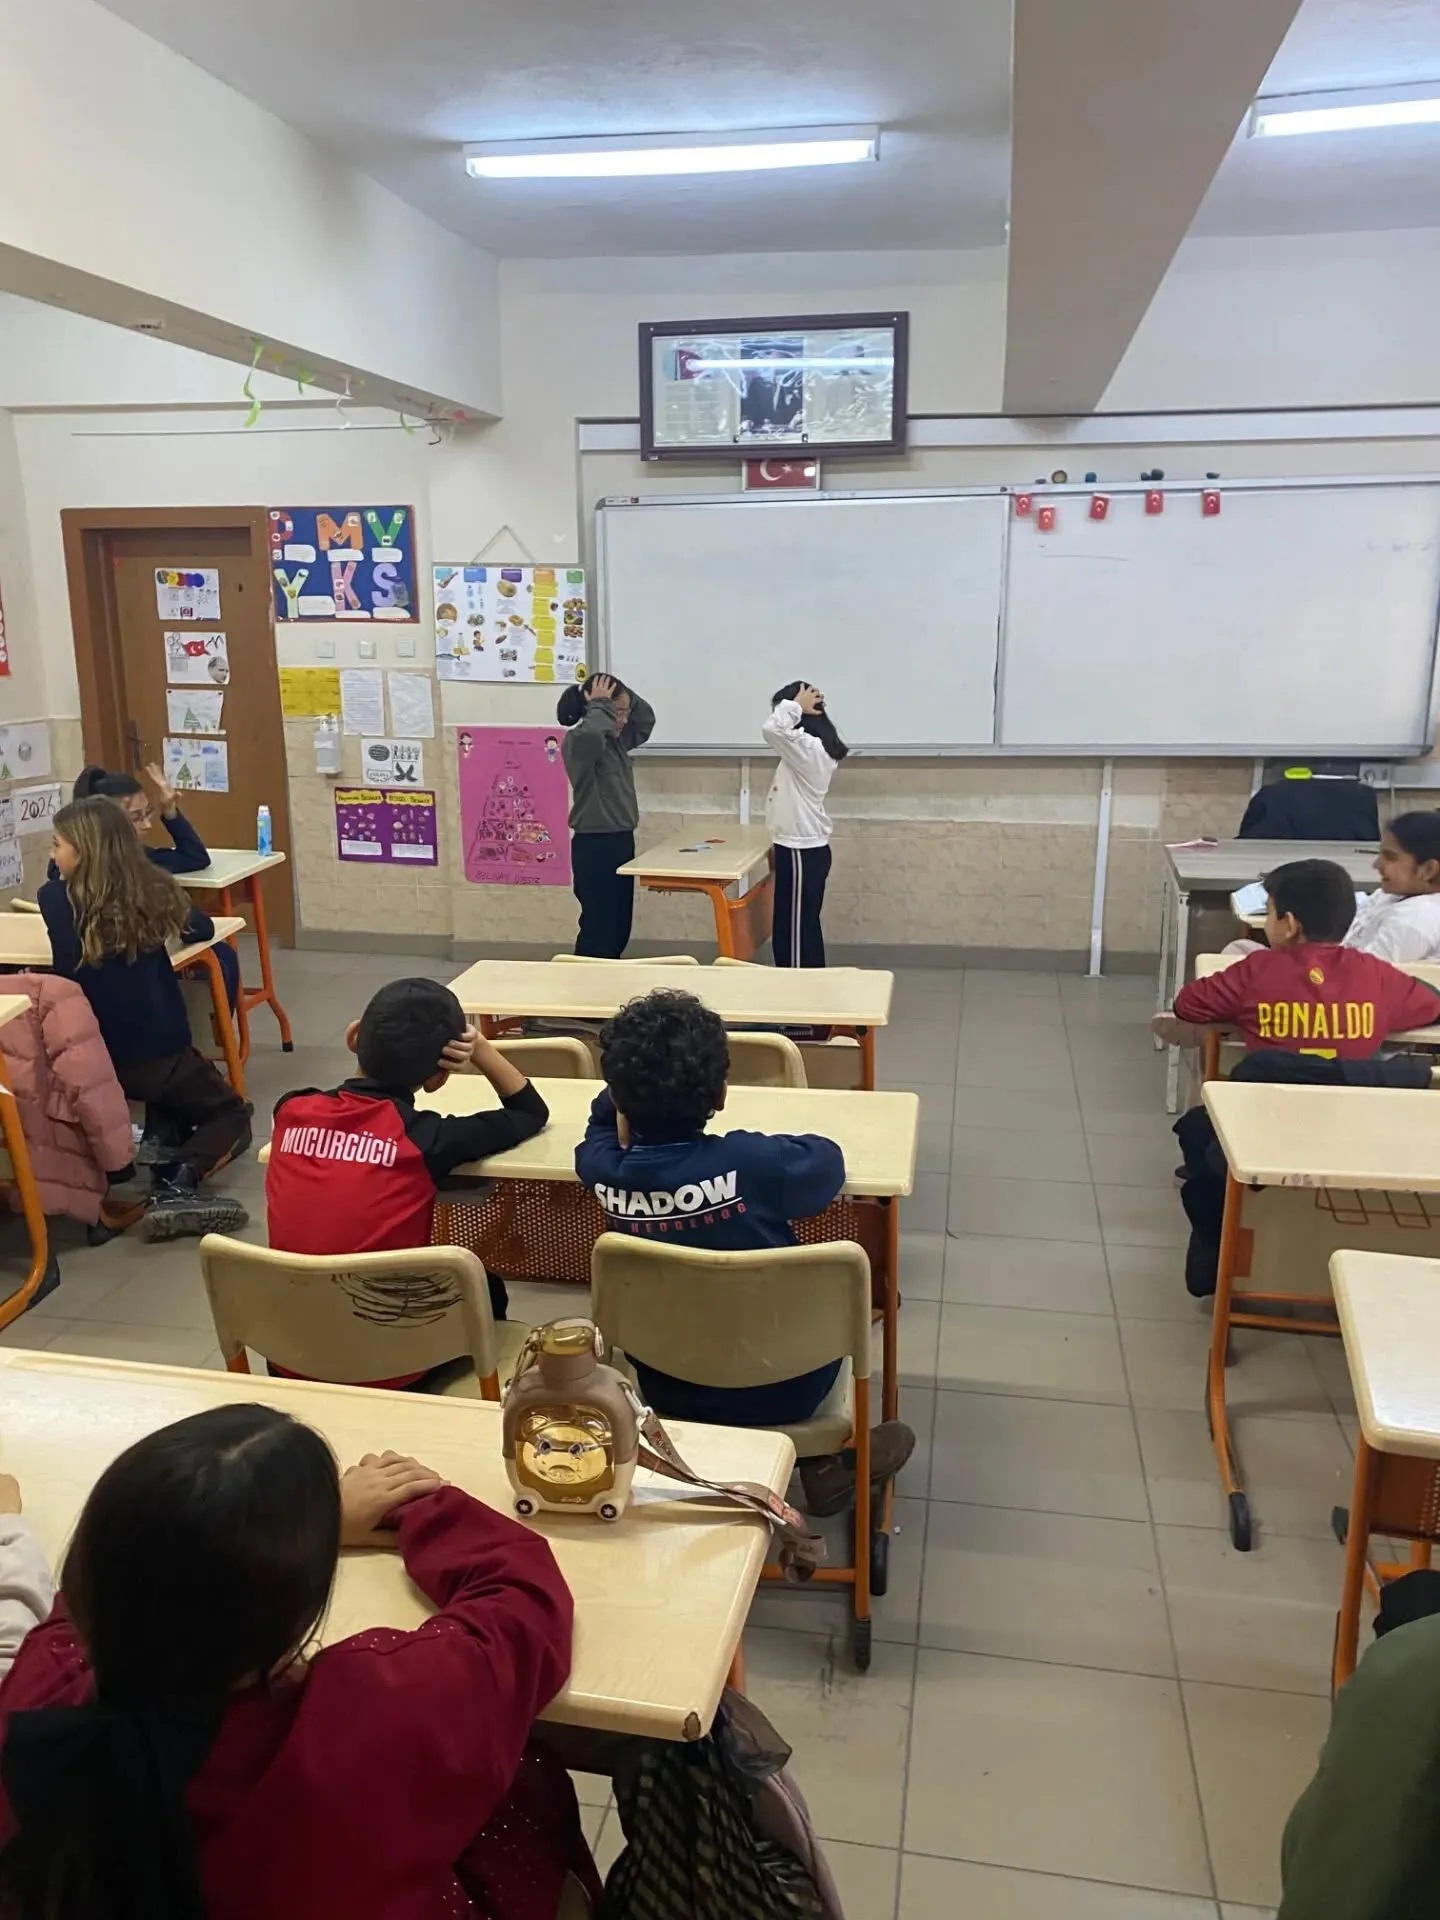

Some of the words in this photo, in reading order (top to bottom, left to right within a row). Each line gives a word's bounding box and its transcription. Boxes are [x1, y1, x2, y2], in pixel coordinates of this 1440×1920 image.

[316, 511, 364, 551] M
[363, 509, 406, 547] V
[273, 568, 309, 619] Y
[21, 796, 56, 822] 2026
[1258, 1002, 1374, 1039] RONALDO
[280, 1127, 398, 1168] MUCURGÜCÜ
[594, 1170, 737, 1216] SHADOW
